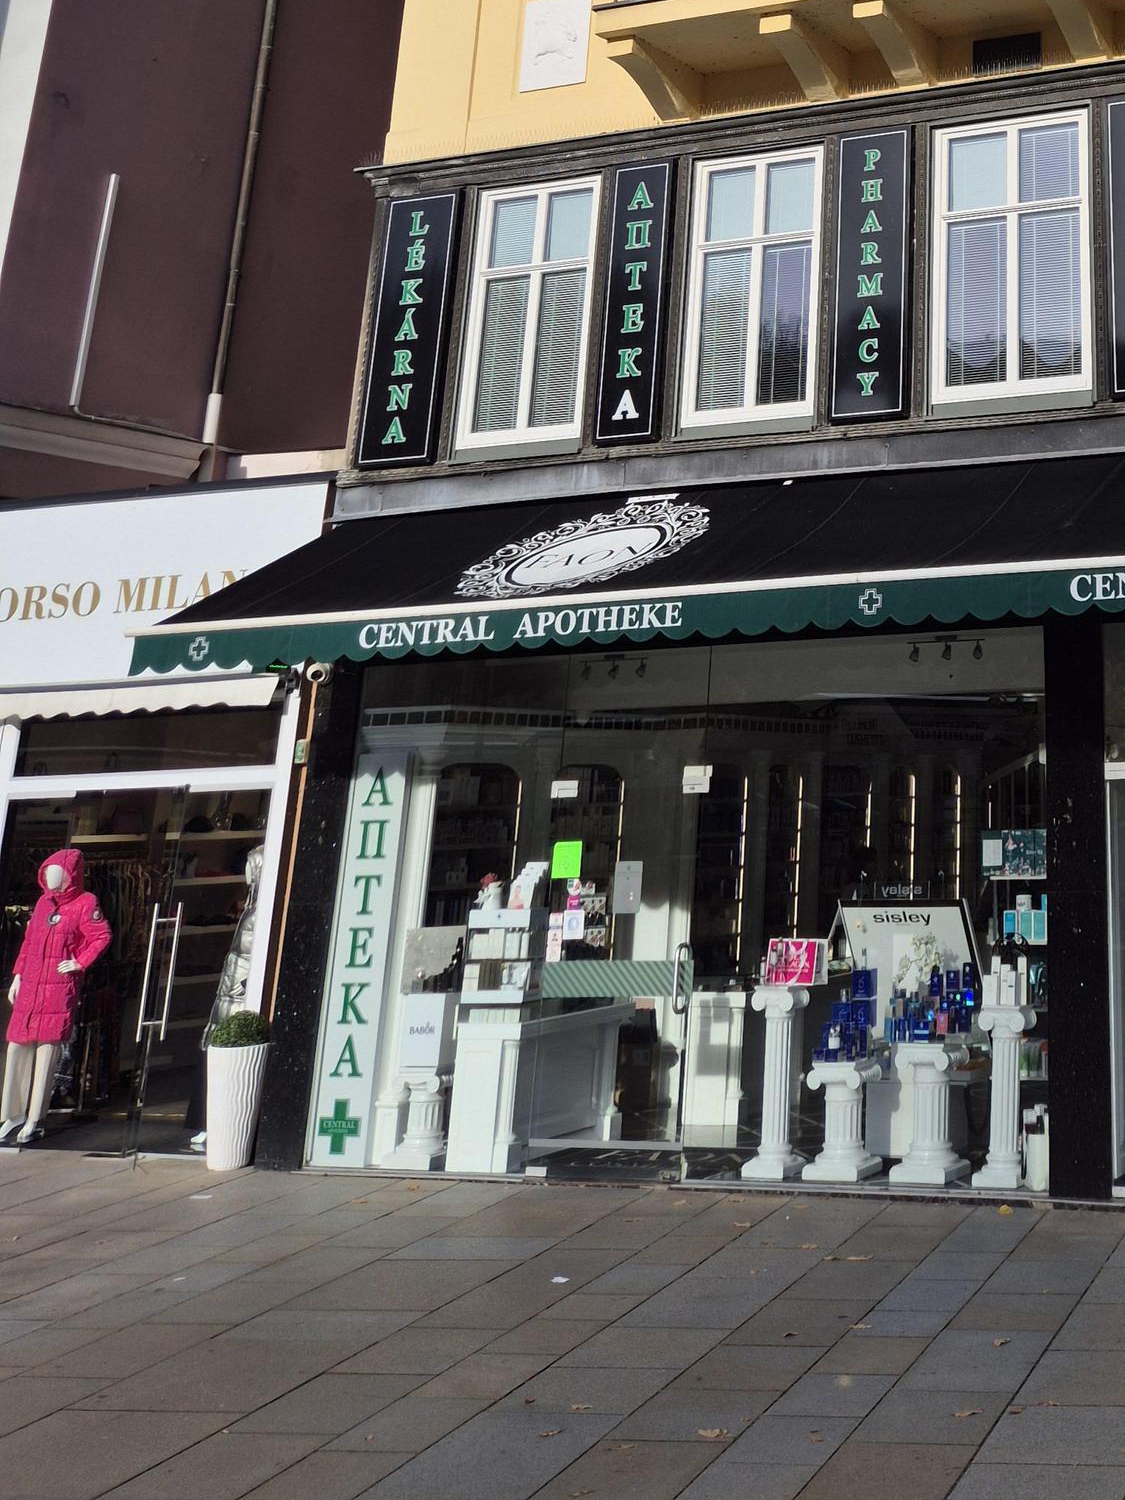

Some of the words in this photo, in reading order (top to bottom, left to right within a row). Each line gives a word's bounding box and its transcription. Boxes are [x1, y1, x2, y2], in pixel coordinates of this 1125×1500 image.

[381, 210, 429, 445] LÉKÁRNA
[611, 181, 654, 421] АПТЕКА
[856, 149, 885, 397] PHARMACY
[359, 615, 495, 649] CENTRAL
[513, 601, 684, 640] APOTHEKE
[523, 541, 653, 570] FAON
[329, 766, 393, 1079] АПТЕКА
[873, 910, 931, 926] sisley
[323, 1120, 356, 1129] CENTRAL
